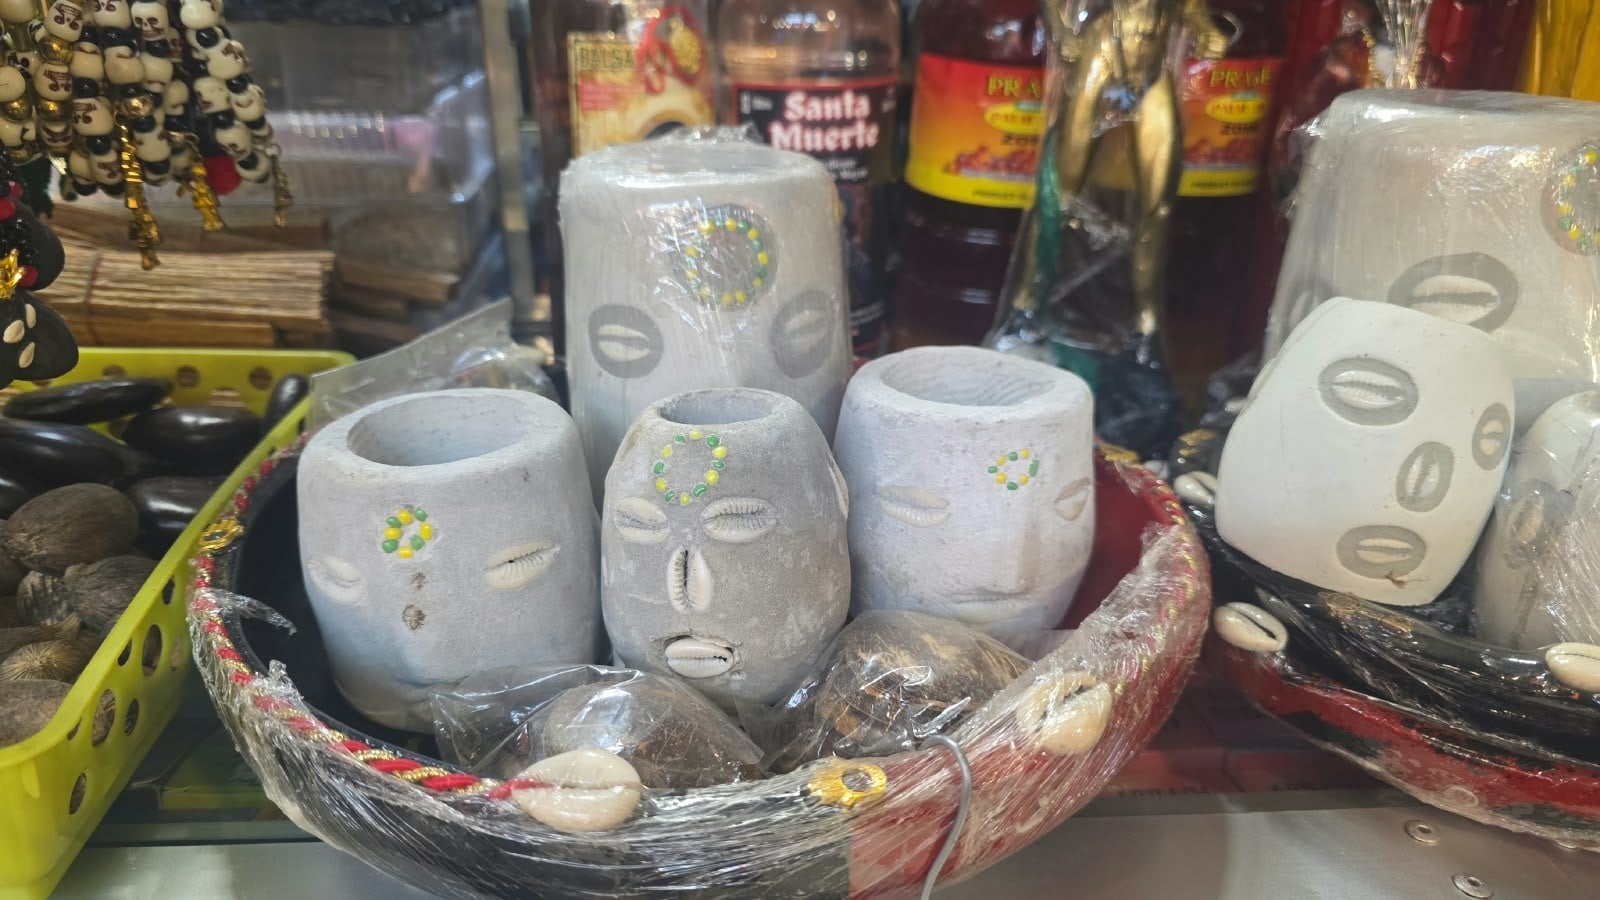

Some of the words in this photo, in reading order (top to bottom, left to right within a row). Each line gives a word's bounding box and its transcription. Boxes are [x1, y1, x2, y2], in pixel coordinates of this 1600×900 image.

[579, 47, 635, 69] BALSA
[987, 74, 1042, 97] PRA
[784, 89, 872, 122] Santa
[768, 119, 880, 152] Muerte
